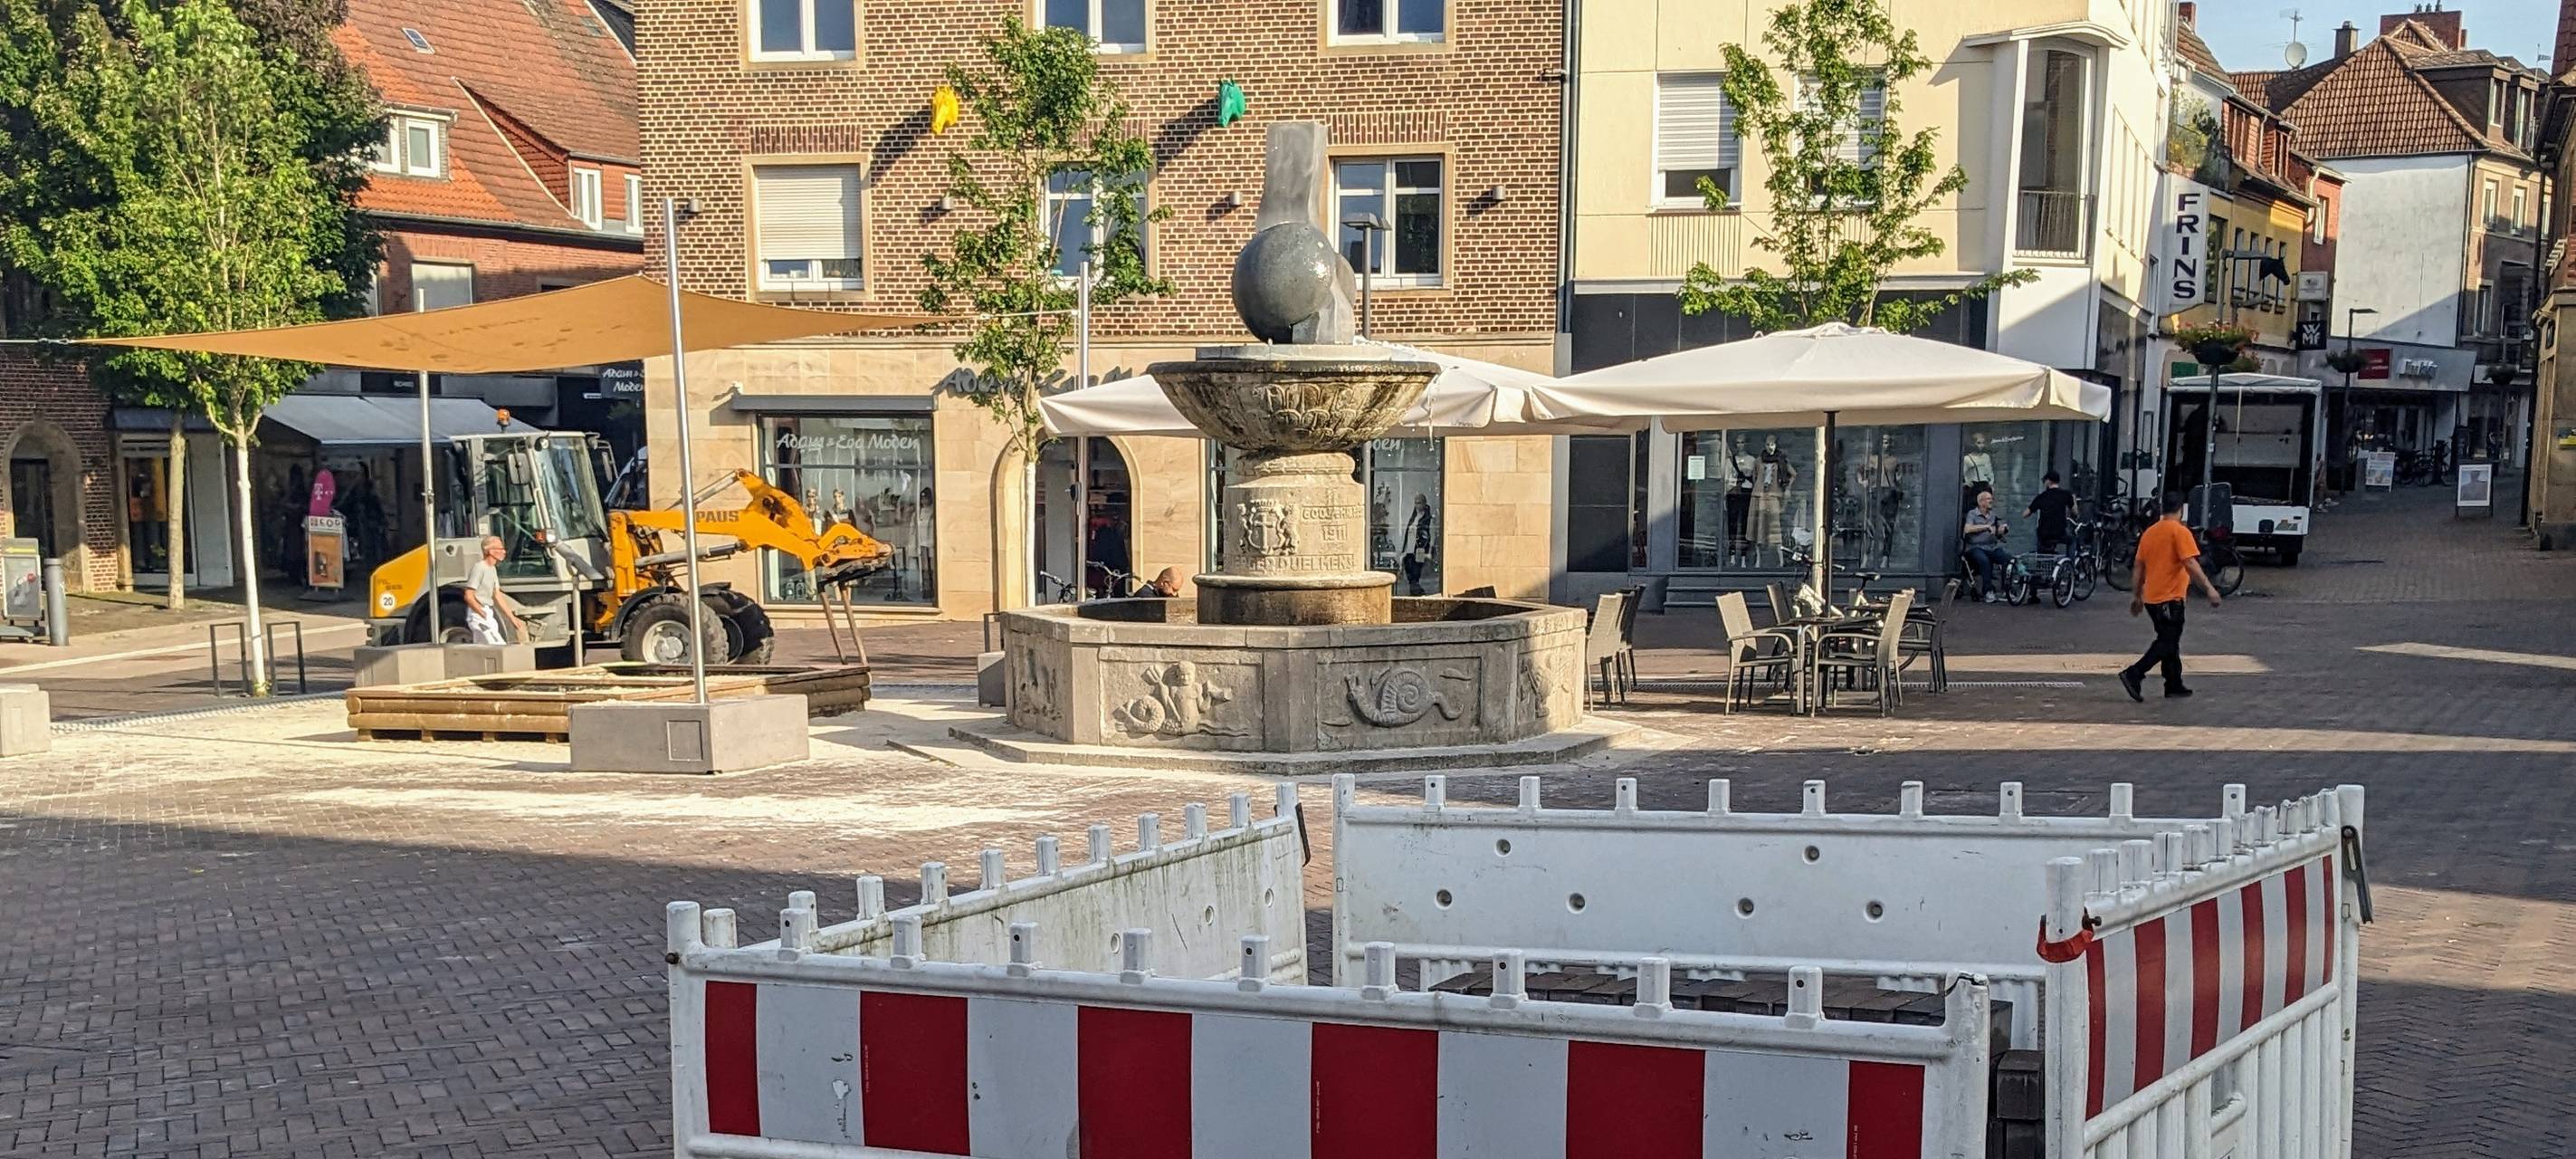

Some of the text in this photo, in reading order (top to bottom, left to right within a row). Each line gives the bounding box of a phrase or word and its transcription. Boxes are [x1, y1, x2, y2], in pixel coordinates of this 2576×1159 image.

[2173, 193, 2200, 300] FRINS
[777, 433, 824, 451] Adam
[868, 434, 921, 450] Moden
[695, 510, 739, 522] PAUS
[383, 597, 394, 606] 20
